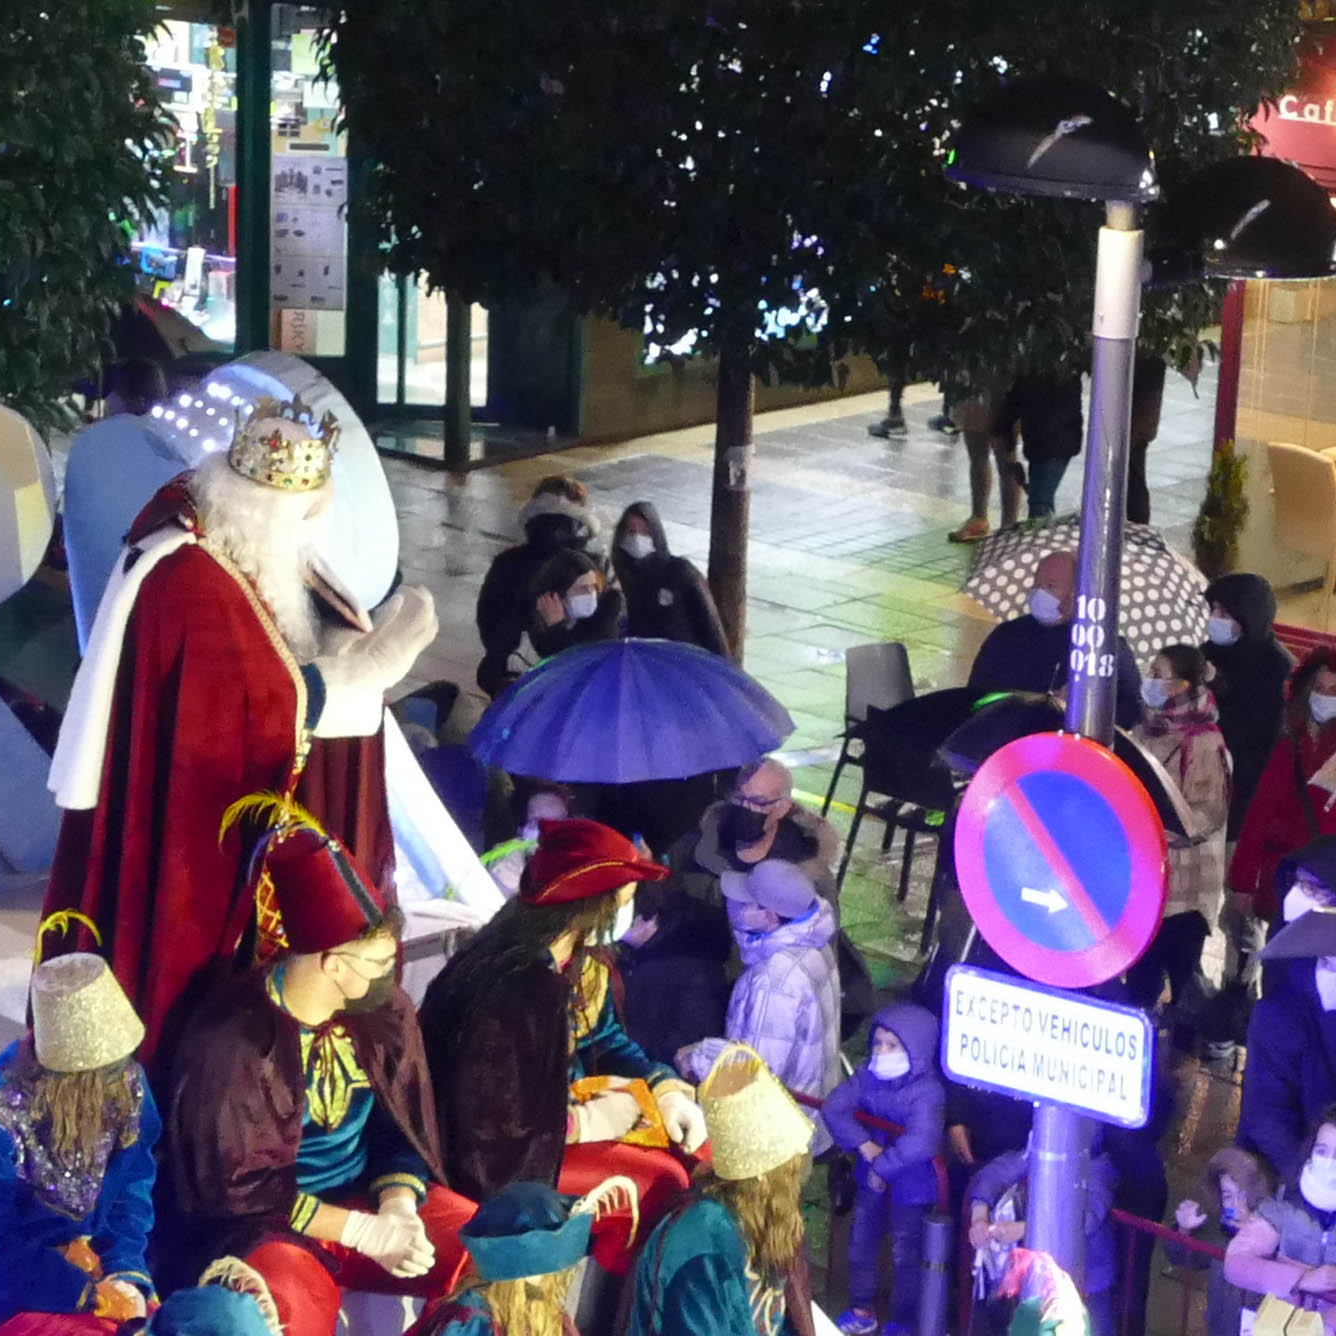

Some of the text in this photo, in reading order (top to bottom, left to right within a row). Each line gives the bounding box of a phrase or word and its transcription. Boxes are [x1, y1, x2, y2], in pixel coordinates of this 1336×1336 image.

[1076, 594, 1107, 622] 10
[1070, 649, 1115, 677] 018
[955, 990, 1138, 1061] EXCEPTO VEHICULOS
[1031, 1053, 1128, 1100] MUNICIPAL
